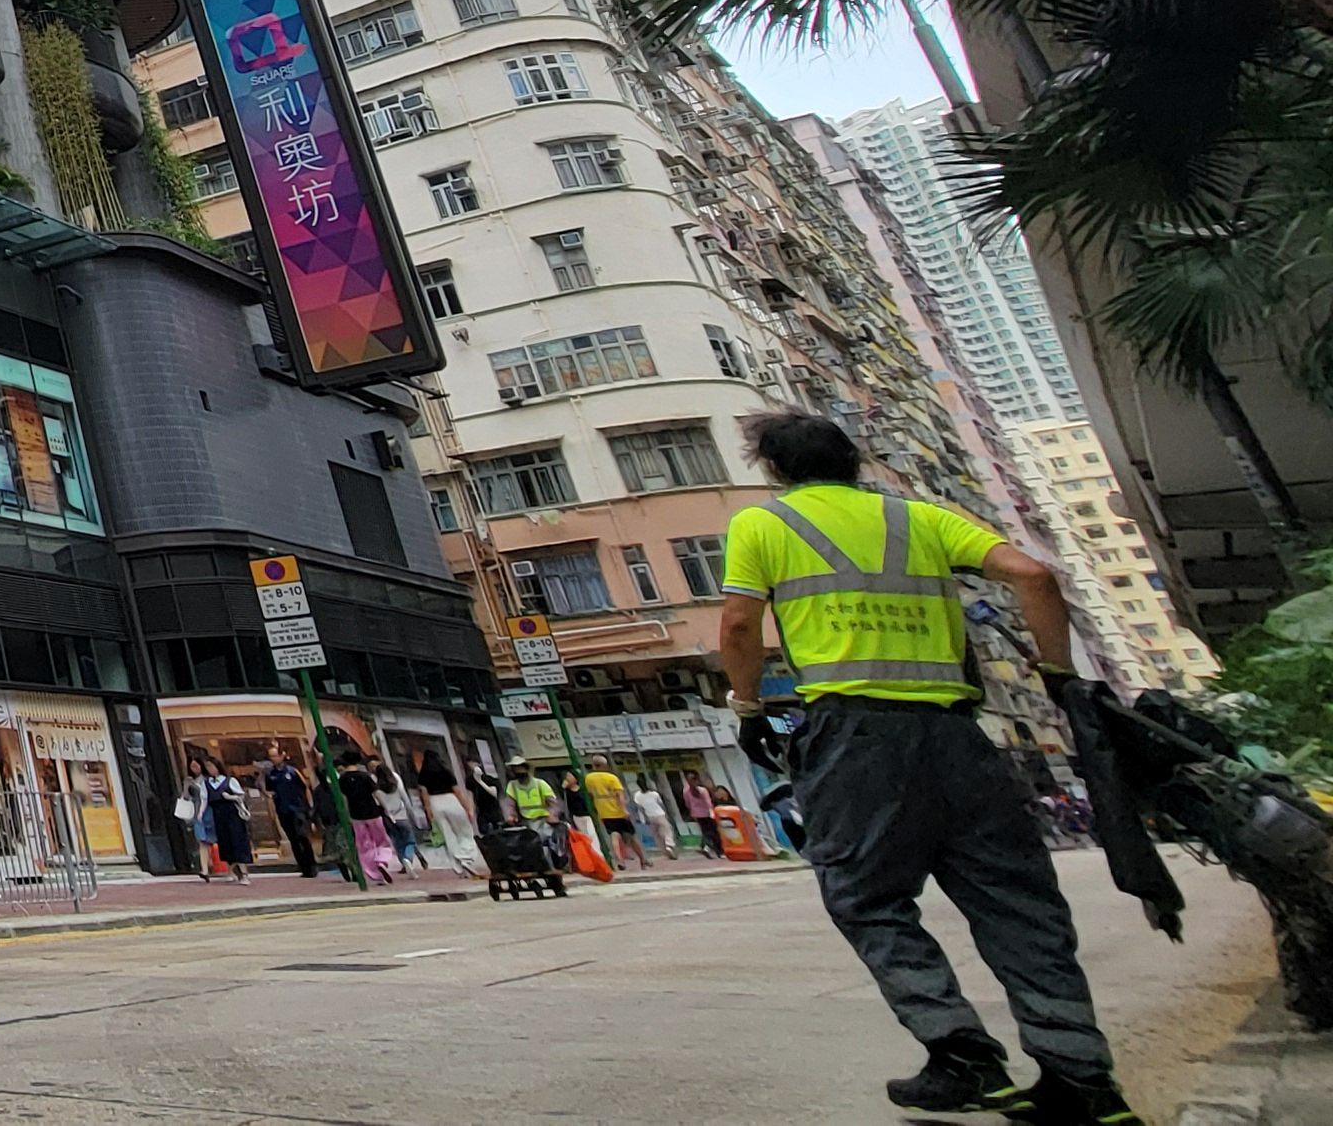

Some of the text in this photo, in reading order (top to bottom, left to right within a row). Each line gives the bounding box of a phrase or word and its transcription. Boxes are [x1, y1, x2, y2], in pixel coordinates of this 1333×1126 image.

[258, 80, 339, 227] 利奧坊
[275, 585, 302, 598] 8-10
[280, 601, 301, 613] 5-7
[529, 638, 552, 648] 8-10
